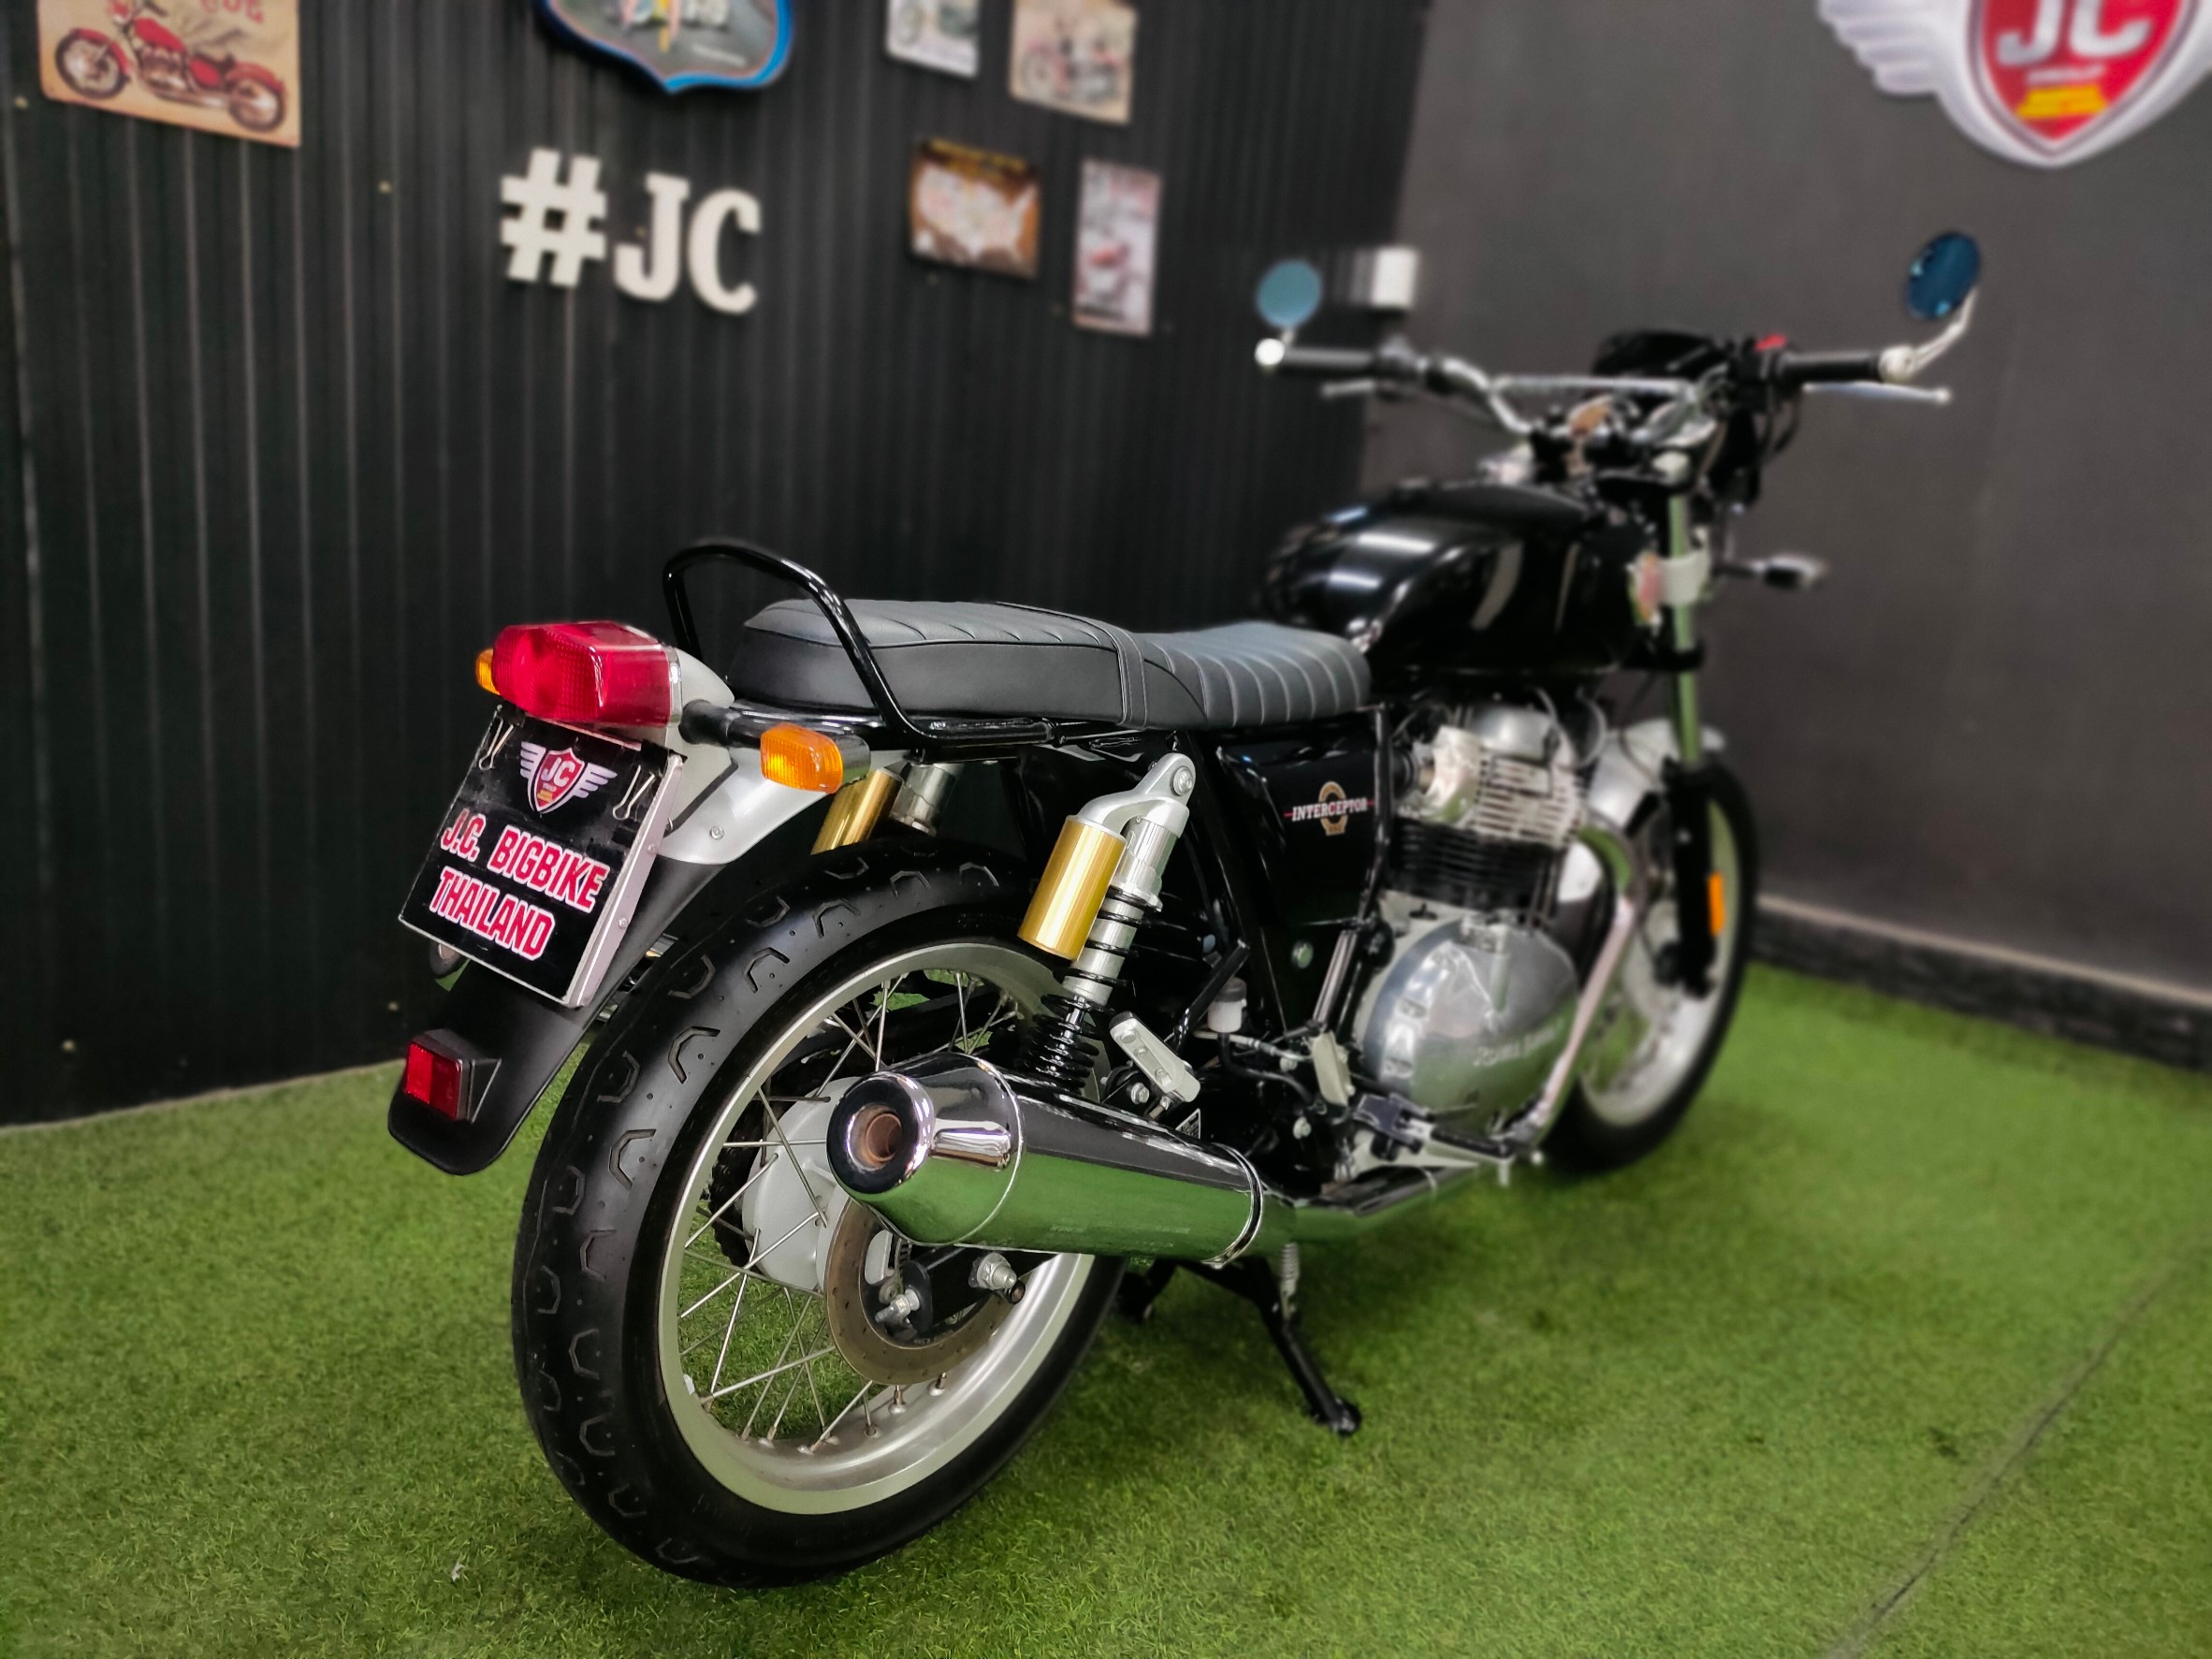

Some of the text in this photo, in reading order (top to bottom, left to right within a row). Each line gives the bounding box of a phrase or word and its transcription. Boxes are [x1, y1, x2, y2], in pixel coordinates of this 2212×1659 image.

[501, 146, 762, 314] #JC
[540, 756, 576, 788] JC
[1291, 797, 1368, 822] INTERCEPTOR
[441, 808, 611, 913] J.C. BIGBIKE
[429, 866, 556, 961] THAILAND
